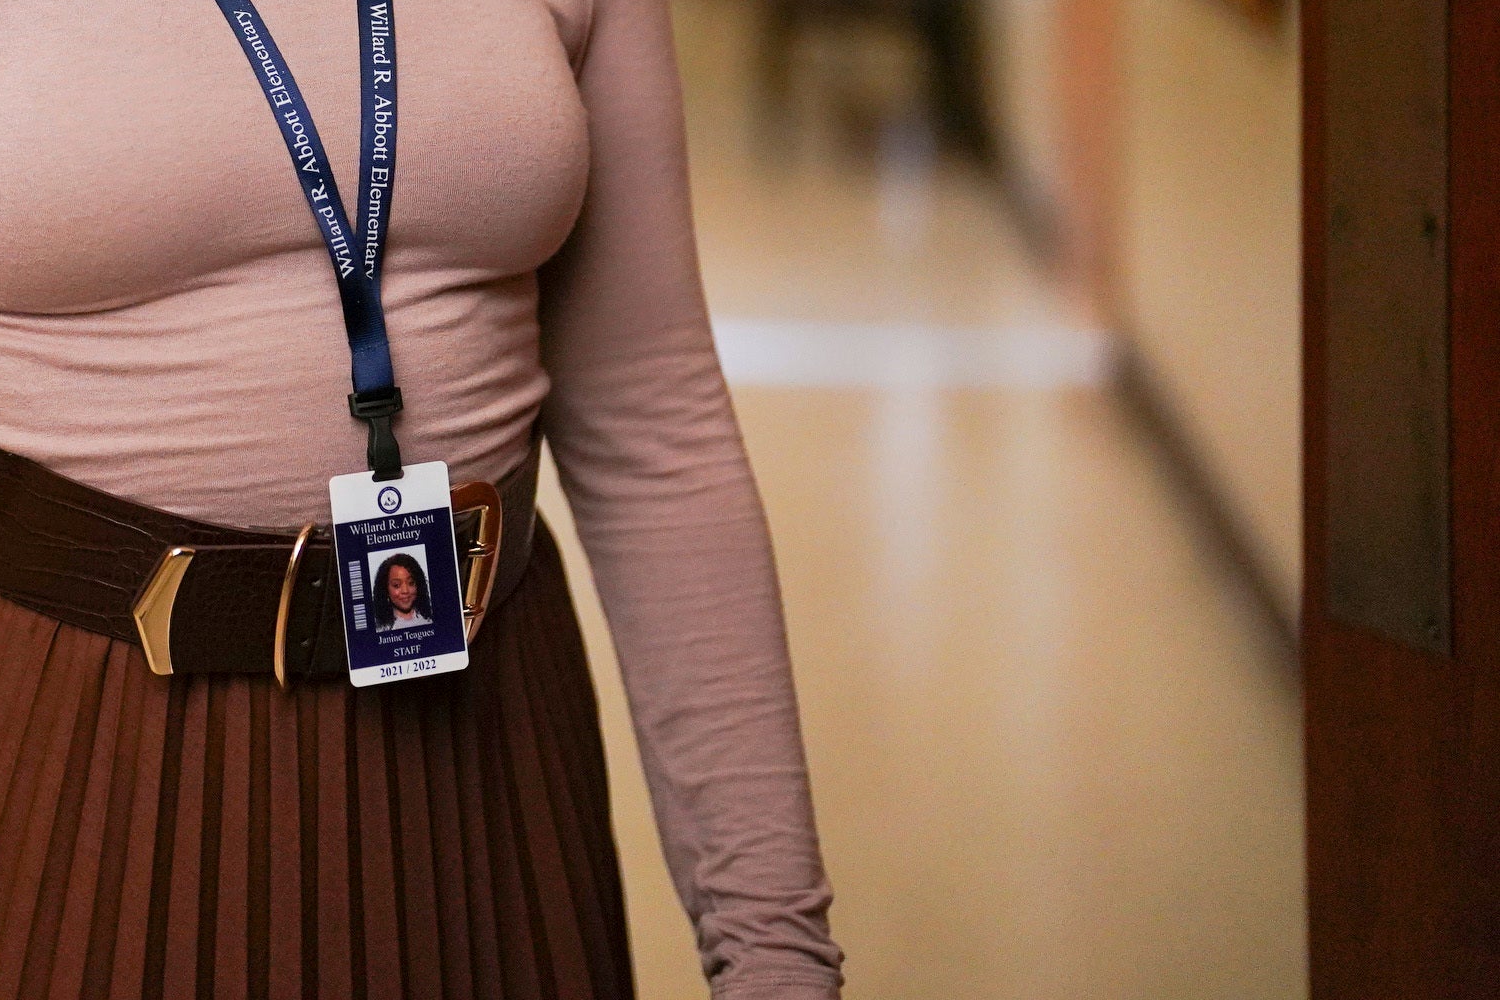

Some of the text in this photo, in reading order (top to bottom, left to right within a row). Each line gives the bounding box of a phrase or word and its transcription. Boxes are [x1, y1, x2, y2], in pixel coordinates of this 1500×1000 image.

[369, 2, 391, 66] Willard
[373, 69, 391, 90] R.
[373, 95, 392, 161] Abbott
[234, 9, 355, 279] Willard R. Abbott Elementary
[350, 514, 435, 535] Willard R. Abbott
[366, 530, 420, 545] Elementary
[378, 629, 435, 645] Janine Teagues
[393, 645, 421, 657] STAFF
[381, 665, 403, 678] 2021
[413, 659, 437, 672] 2022
